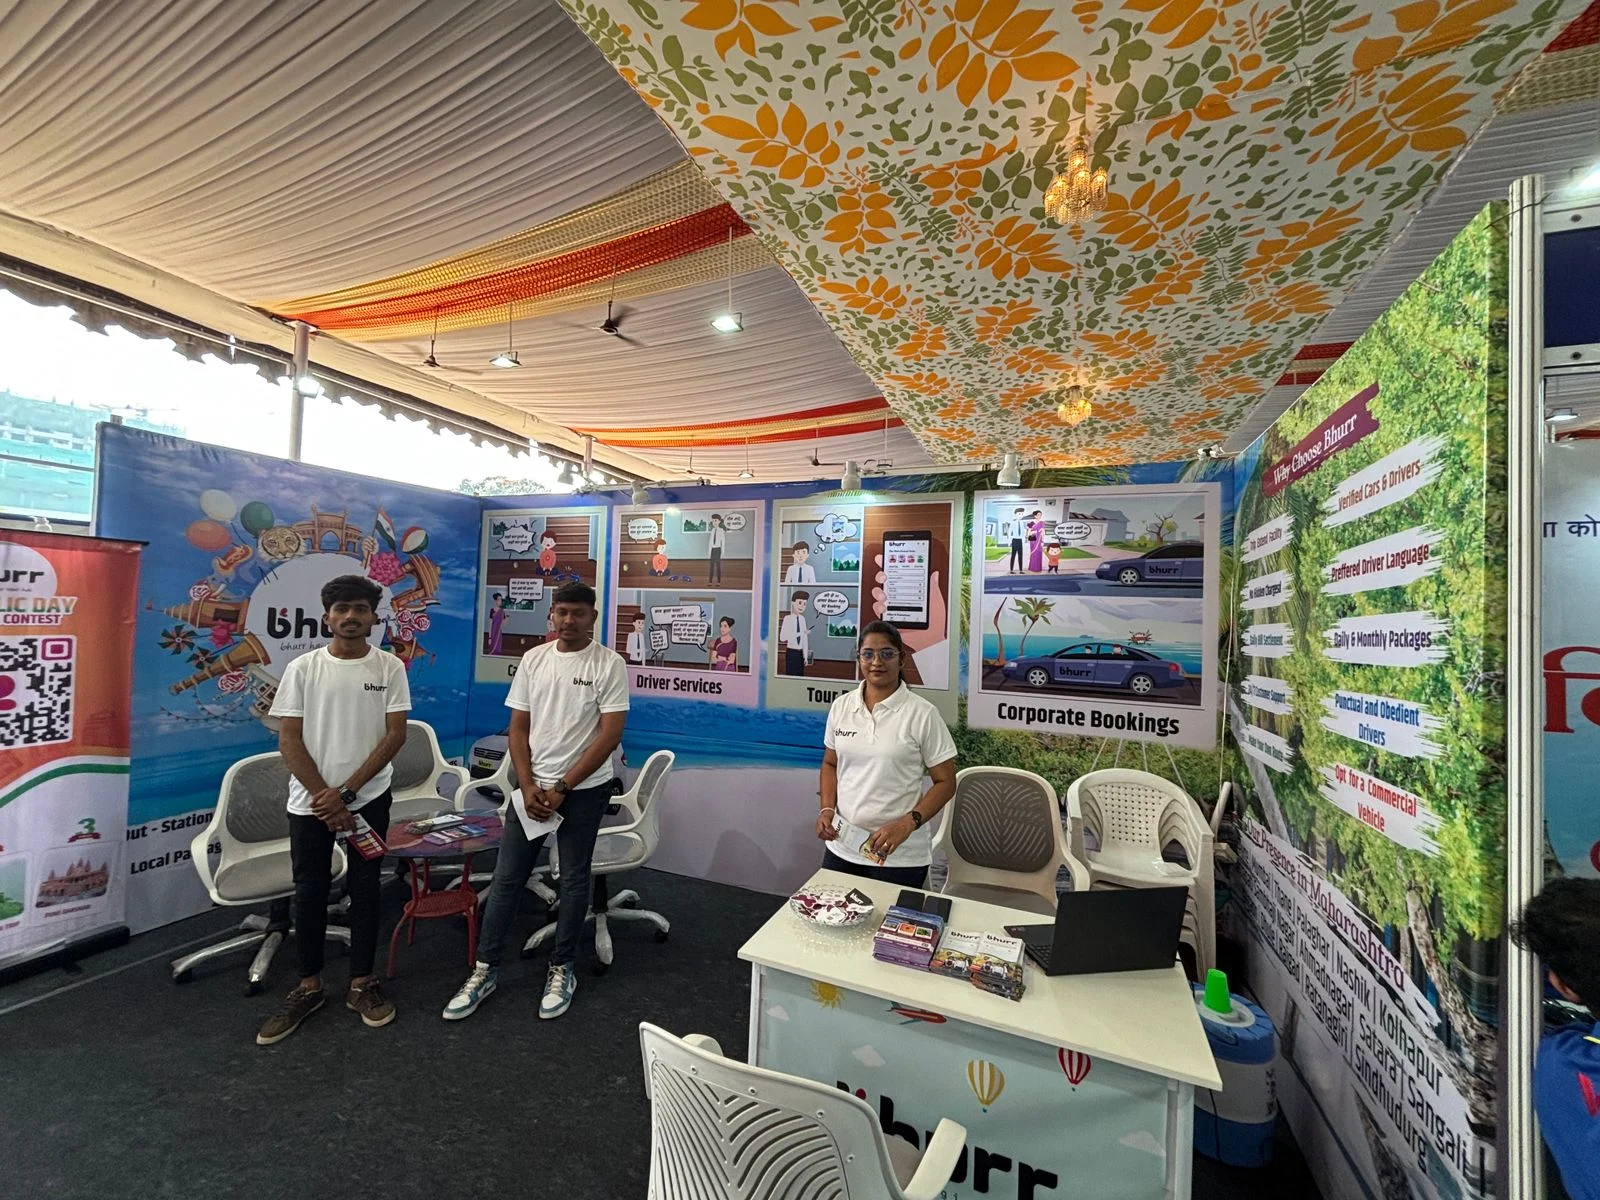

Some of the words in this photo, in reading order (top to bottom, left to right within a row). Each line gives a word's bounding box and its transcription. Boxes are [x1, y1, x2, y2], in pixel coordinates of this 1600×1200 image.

[1273, 464, 1291, 485] Why
[1292, 441, 1322, 472] Choose
[1323, 414, 1357, 451] Bhurr
[1339, 485, 1363, 511] Verified
[1364, 478, 1380, 499] Cars
[1382, 474, 1387, 491] &
[1389, 459, 1421, 488] Drivers
[1148, 565, 1180, 575] bhurr
[1332, 559, 1361, 582] Preffered
[1362, 555, 1384, 575] Driver
[1386, 544, 1429, 569] Language
[4, 614, 61, 624] CONTEST
[33, 597, 75, 613] DAY
[1334, 631, 1350, 650] Daily
[1351, 634, 1356, 647] &
[1357, 630, 1387, 650] Monthly
[1389, 629, 1432, 651] Packages
[573, 677, 593, 686] bhur
[636, 674, 671, 691] Driver
[673, 677, 723, 694] Services
[1059, 666, 1092, 677] bhurr
[364, 683, 388, 692] bhurr
[807, 687, 838, 703] Tour
[997, 703, 1085, 727] Corporate
[1090, 710, 1180, 737] Bookings
[1335, 693, 1363, 713] Punctual
[1364, 699, 1378, 717] and
[1380, 701, 1419, 726] Obedient
[1358, 723, 1386, 746] Drivers
[1335, 764, 1346, 784] Opt
[1348, 769, 1359, 789] for
[1360, 778, 1365, 792] a
[1367, 779, 1417, 818] Commercial
[161, 813, 213, 833] Station
[1357, 802, 1385, 832] Vehicle
[130, 852, 170, 874] Local
[174, 842, 222, 863] Paag
[1261, 828, 1296, 878] Presence
[1297, 864, 1308, 893] in
[1310, 875, 1405, 993] Maharashtra
[1296, 903, 1330, 963] Palaghar
[1336, 950, 1370, 1012] Nashik
[1379, 999, 1443, 1096] Kolhapur
[1304, 974, 1349, 1054] Ratanagiri
[1354, 1045, 1428, 1174] Sindhudurg
[1359, 1012, 1397, 1084] Satara
[1407, 1076, 1469, 1177] Sangali
